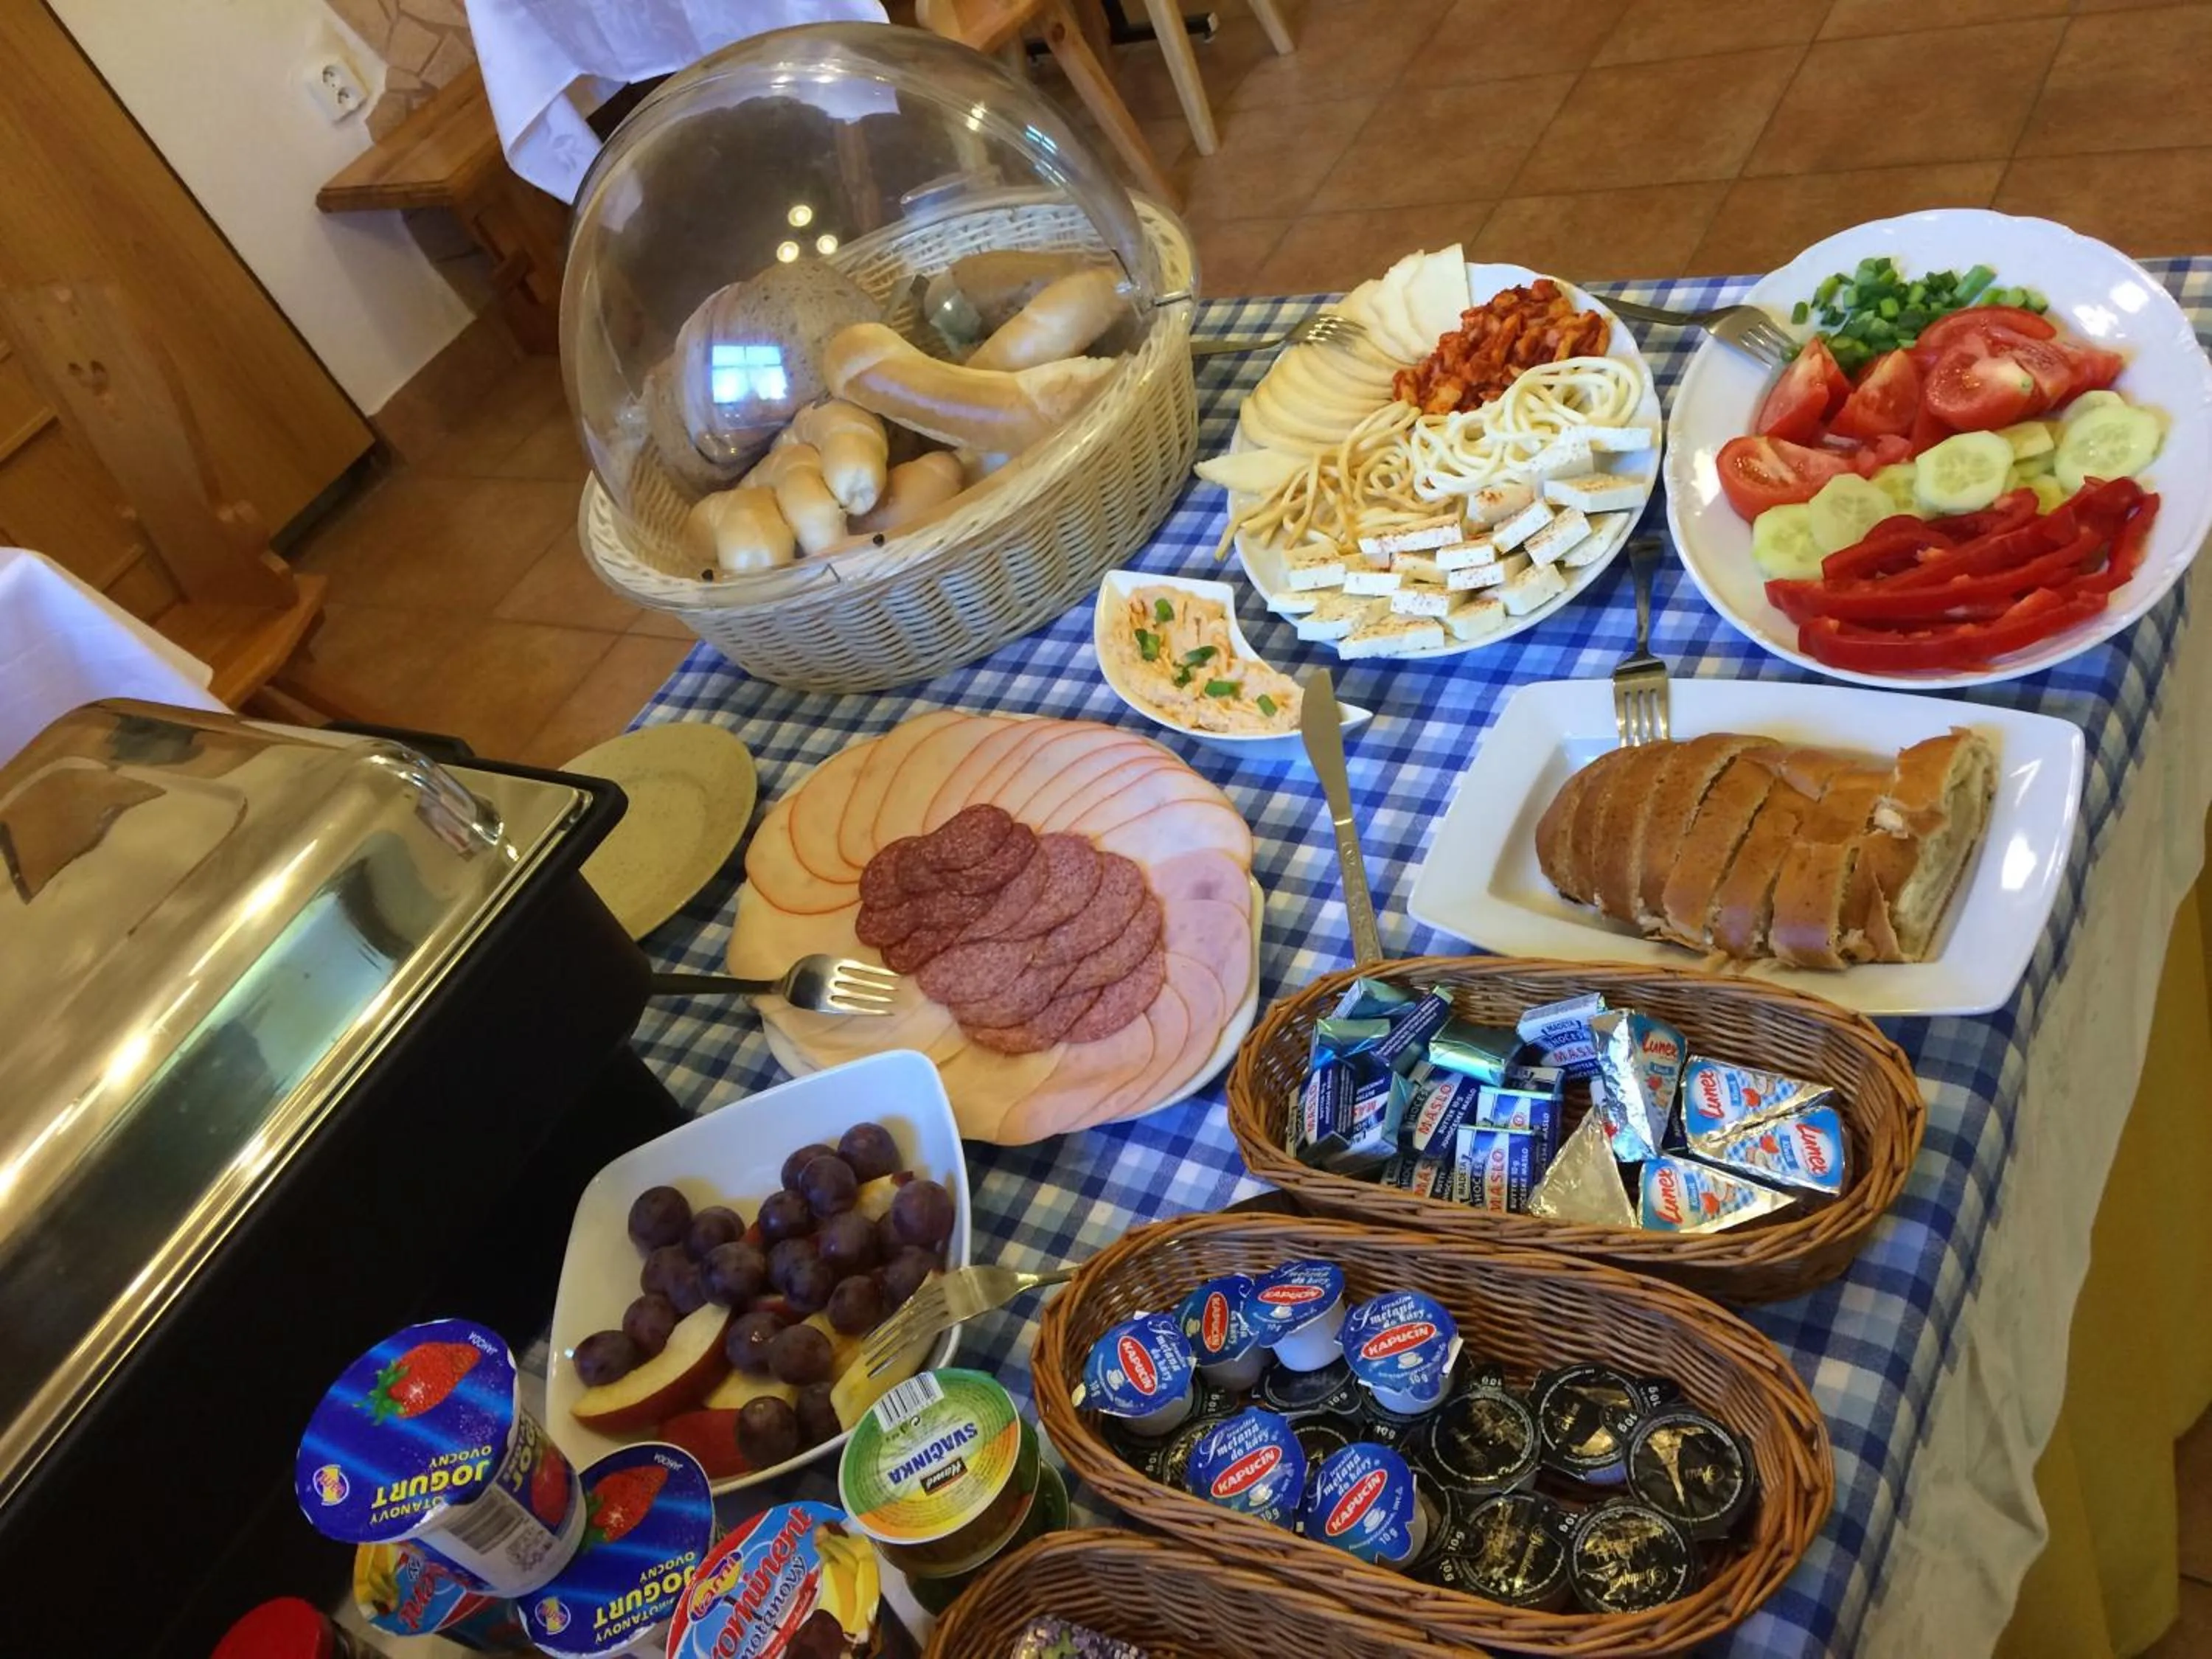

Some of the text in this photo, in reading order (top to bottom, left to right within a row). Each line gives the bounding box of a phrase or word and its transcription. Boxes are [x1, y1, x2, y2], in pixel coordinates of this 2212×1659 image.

[372, 1459, 488, 1507] JOGURT
[887, 1421, 980, 1486] SVAČINKA
[594, 1565, 693, 1627] JOGURT
